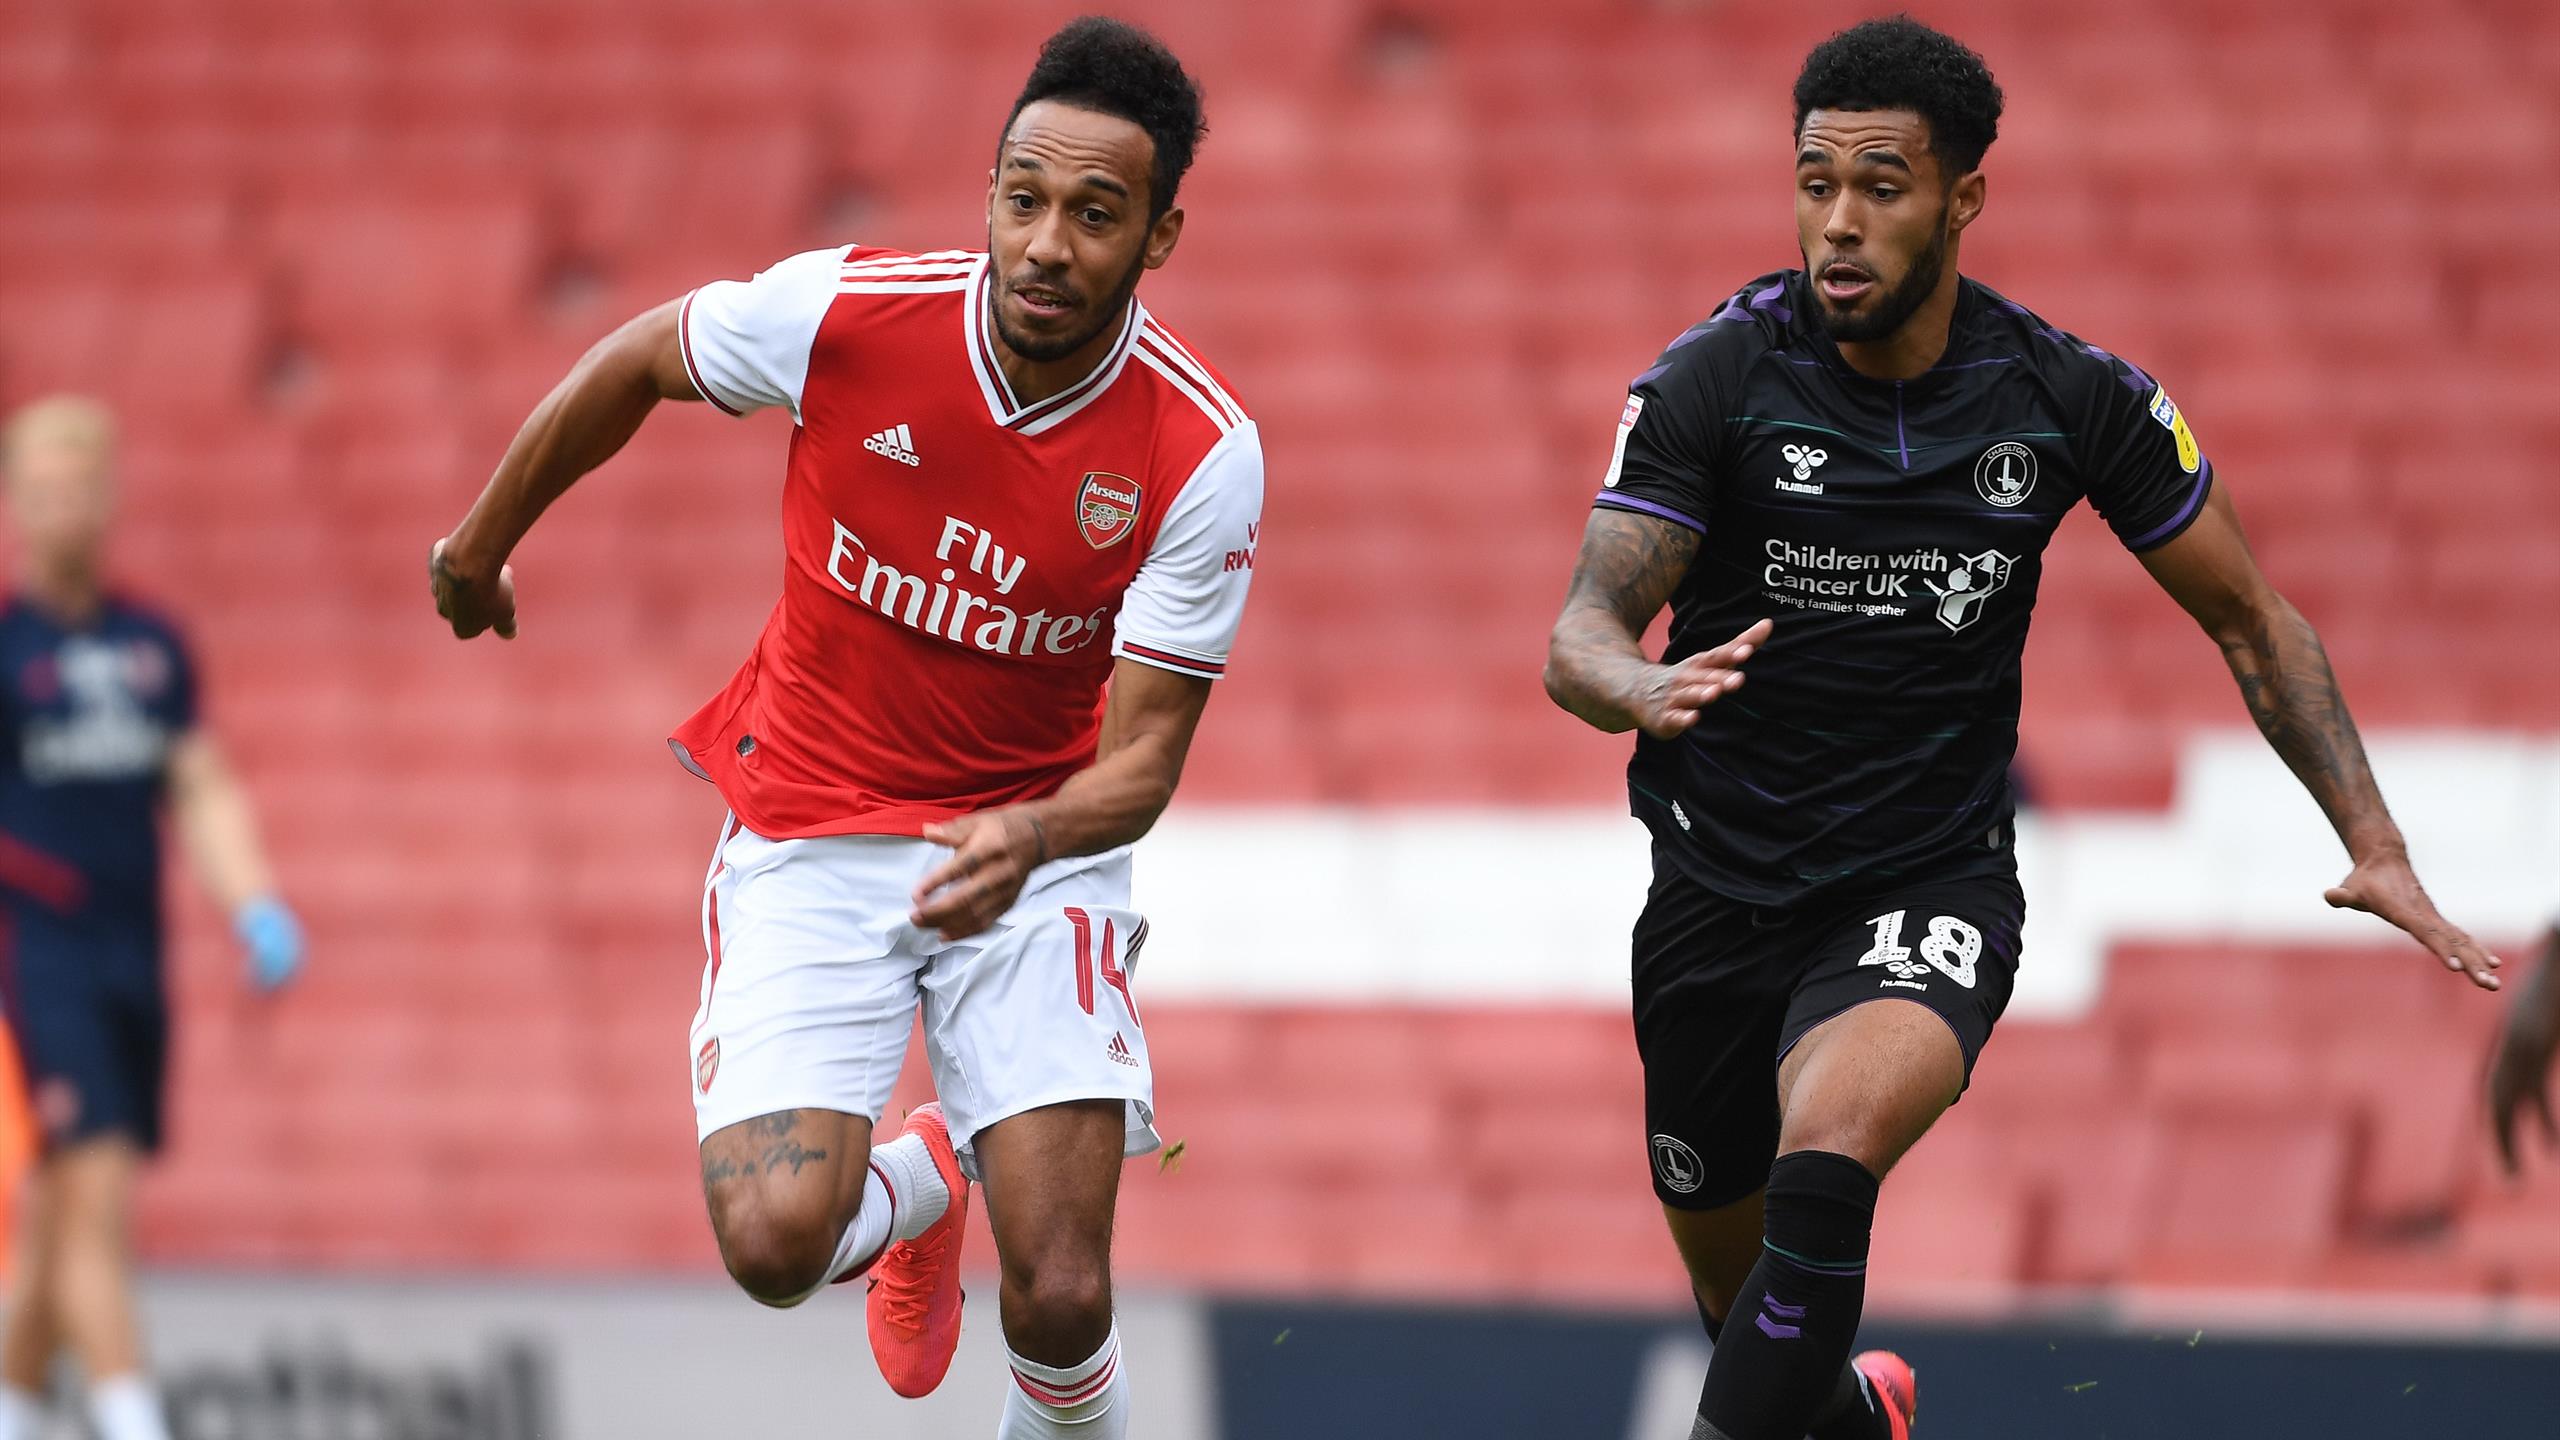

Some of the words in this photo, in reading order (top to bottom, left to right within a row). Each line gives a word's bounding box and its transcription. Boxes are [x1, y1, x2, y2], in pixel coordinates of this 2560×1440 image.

[863, 438, 920, 467] adidas
[1987, 445, 2029, 459] CHARLTON
[1087, 482, 1135, 505] Arsenal
[1775, 477, 1824, 495] hummel
[1988, 491, 2022, 504] ATHLETIC
[935, 515, 1026, 595] Fly
[1765, 539, 1879, 571] Children
[1888, 548, 1948, 572] with
[827, 517, 1107, 656] Emirates
[1764, 563, 1860, 596] Cancer
[1866, 574, 1910, 598] UK
[1808, 599, 1853, 613] families
[1856, 603, 1907, 616] together
[1857, 910, 1982, 989] 18
[1064, 907, 1140, 1028] 14
[1879, 979, 1928, 992] hummel
[1107, 1050, 1139, 1067] adidas
